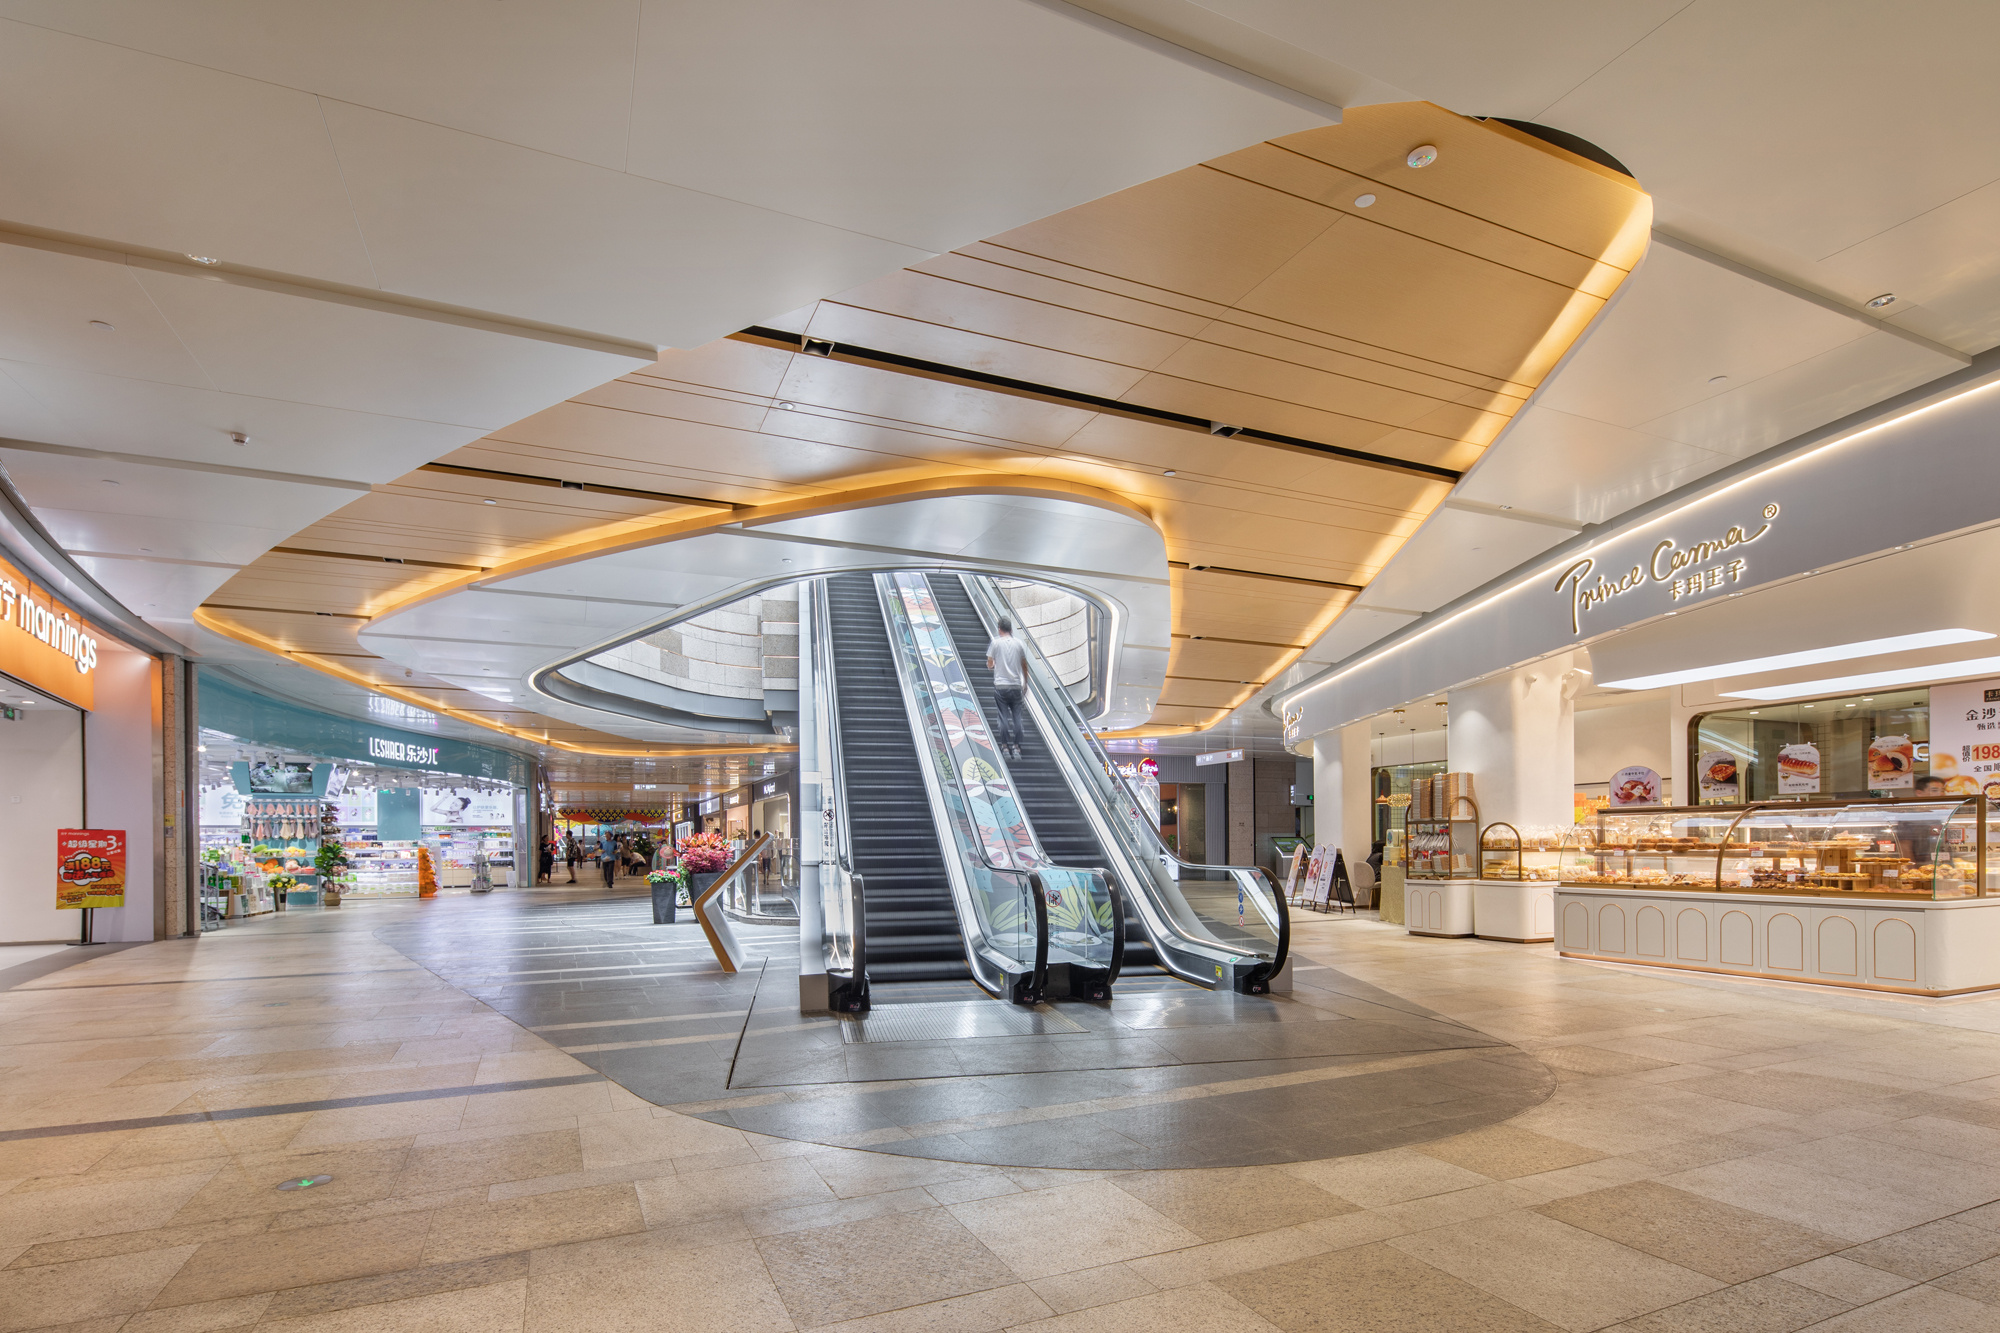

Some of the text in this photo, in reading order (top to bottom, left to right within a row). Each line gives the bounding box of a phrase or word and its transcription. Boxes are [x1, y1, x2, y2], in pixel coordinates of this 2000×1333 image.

[0, 577, 16, 621] 宁
[1554, 558, 1647, 635] Prince
[1650, 524, 1770, 582] Carma
[1667, 558, 1747, 601] 卡玛王子
[20, 593, 97, 674] mannings
[1965, 708, 2000, 721] 金沙
[1976, 722, 2000, 731] 甄选
[369, 737, 438, 765] LESHAER 乐沙儿
